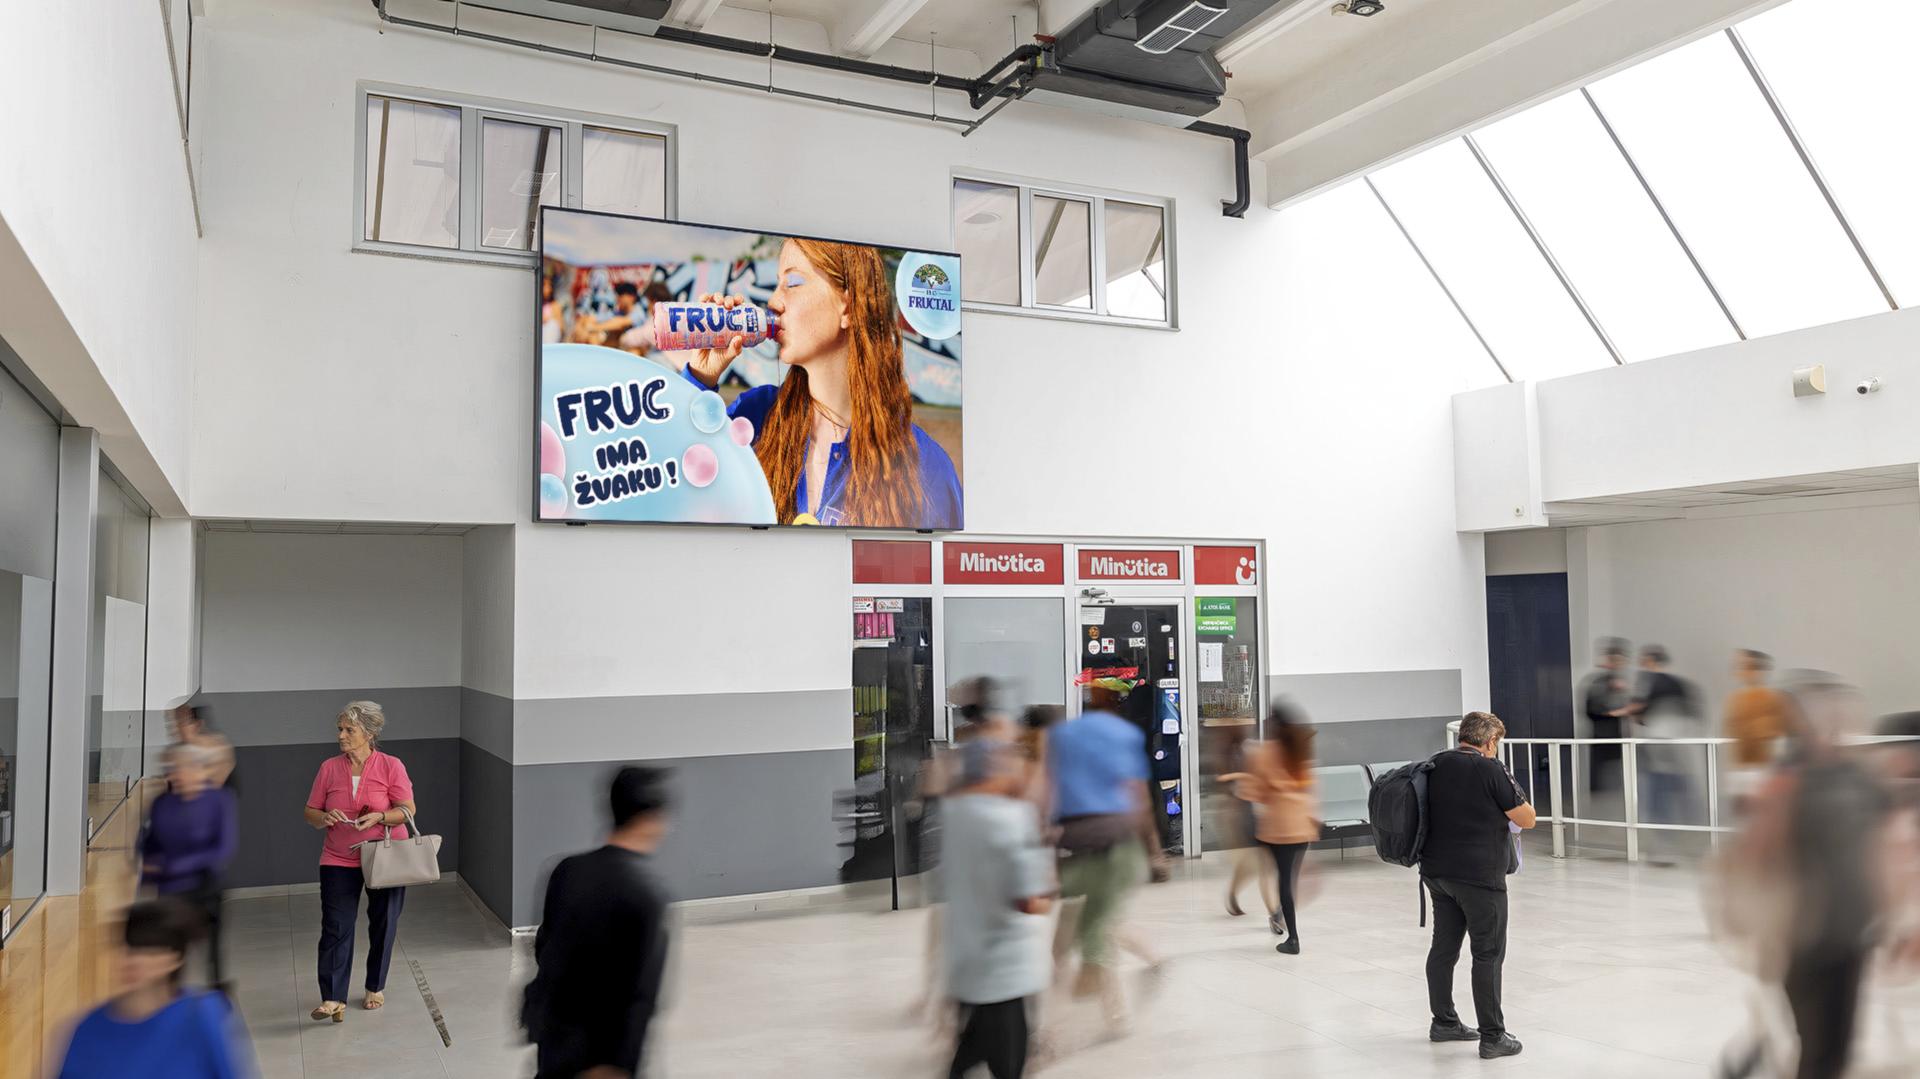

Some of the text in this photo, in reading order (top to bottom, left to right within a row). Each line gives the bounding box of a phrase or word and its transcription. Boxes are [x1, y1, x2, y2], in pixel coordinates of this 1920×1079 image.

[908, 295, 956, 312] FRUCTAL
[556, 379, 671, 437] FRUC
[596, 439, 648, 470] IMA
[574, 466, 662, 505] ŽVAKU
